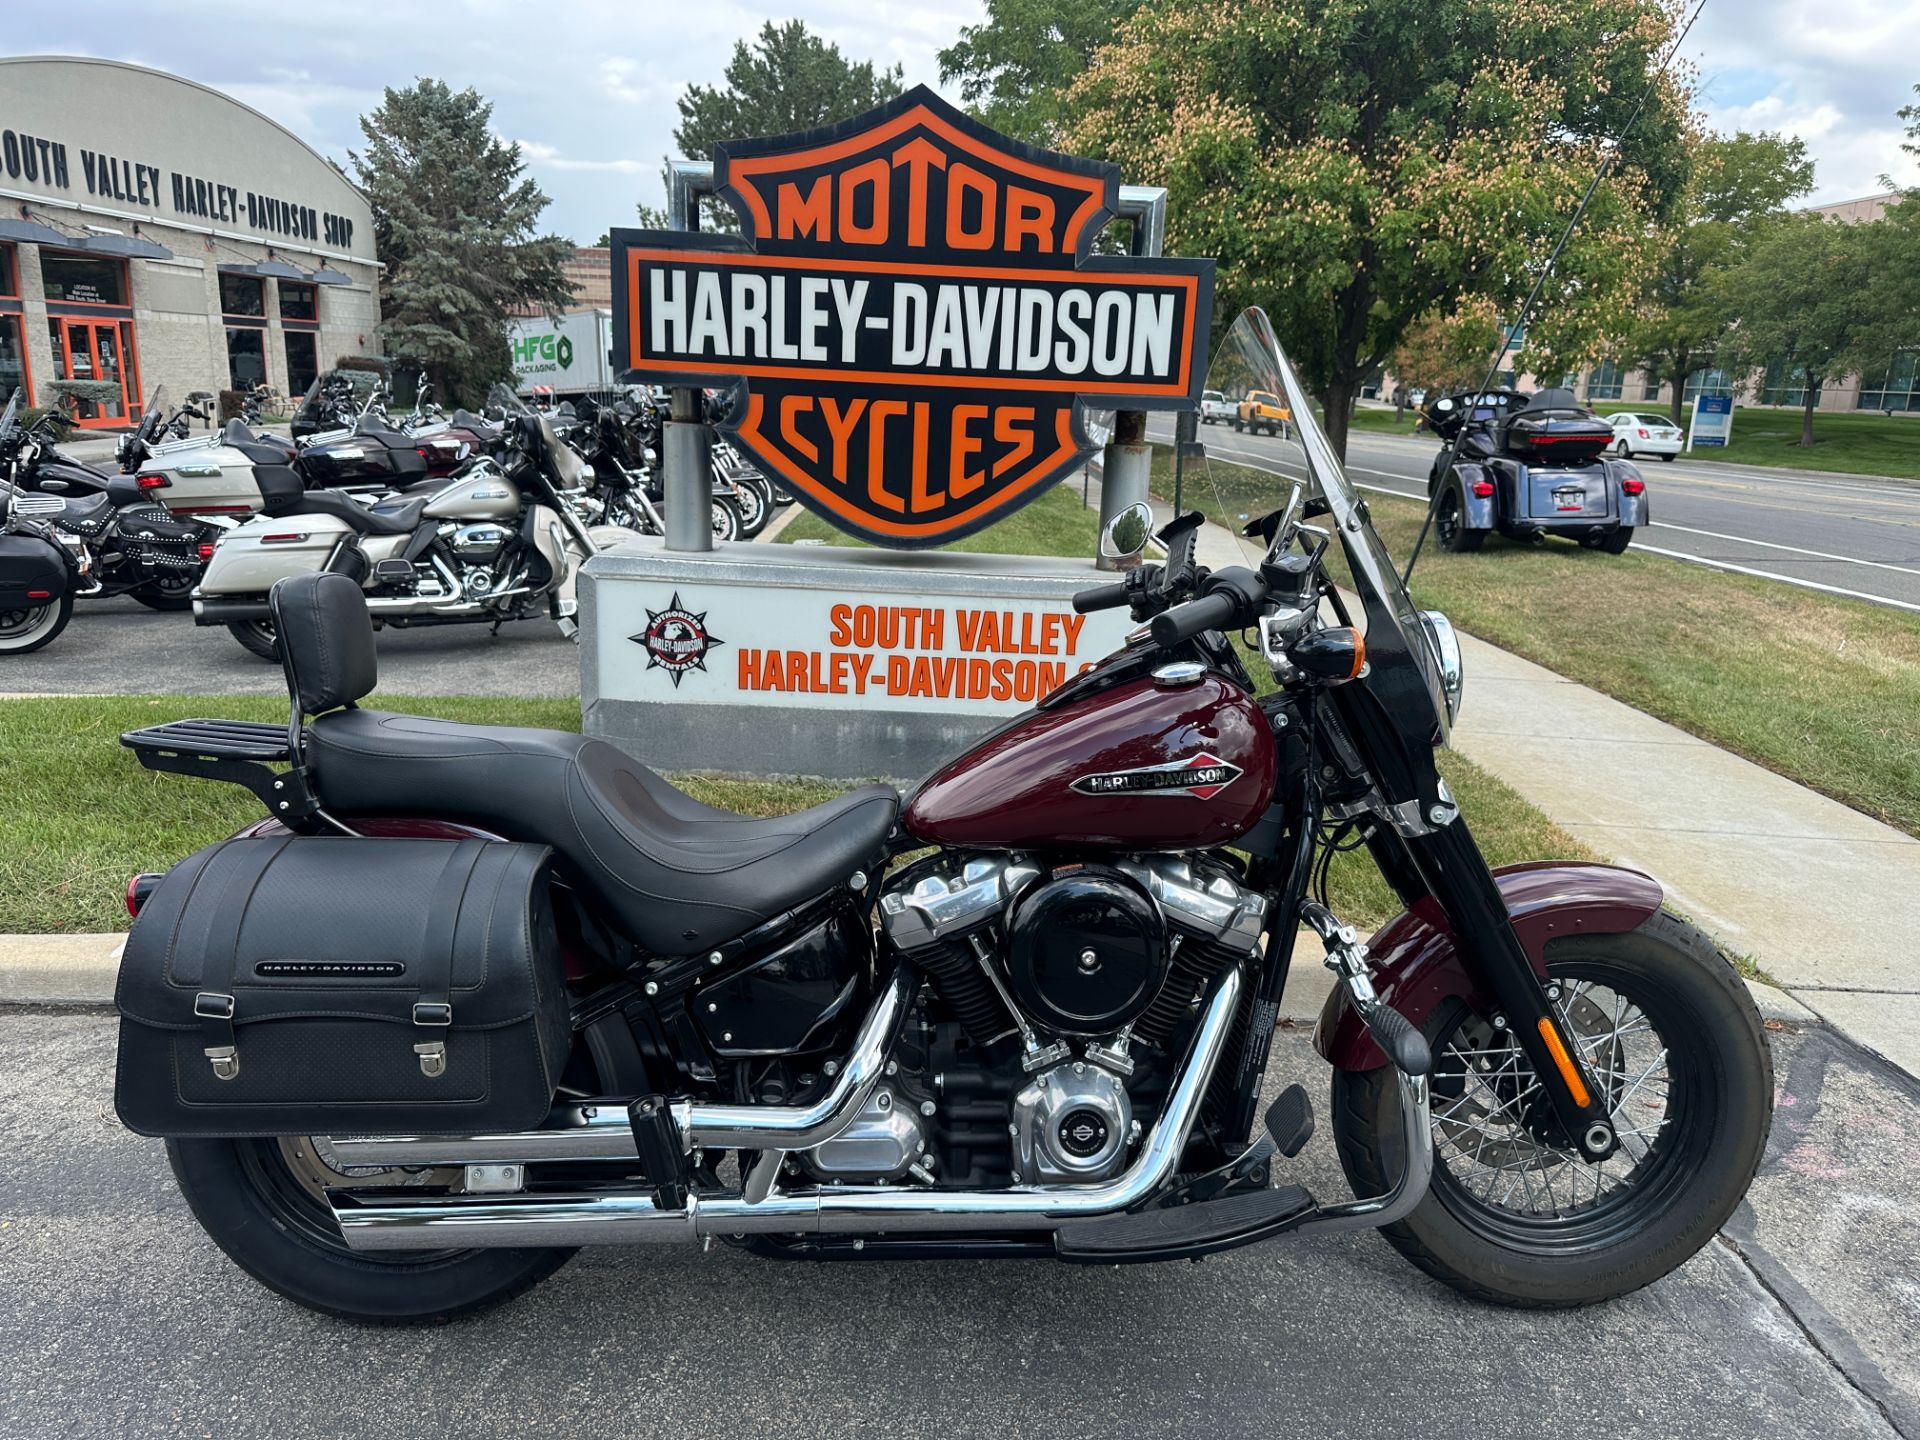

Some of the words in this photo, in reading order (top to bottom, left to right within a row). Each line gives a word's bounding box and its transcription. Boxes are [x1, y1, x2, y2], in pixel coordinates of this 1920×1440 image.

[0, 129, 70, 190] OUTH
[80, 149, 160, 208] VALLEY
[171, 172, 318, 241] HARLEY-DAVIDSON
[323, 211, 353, 249] SHOP
[778, 137, 1056, 254] MOTOR
[650, 268, 1176, 378] HARLEY-DAVIDSON
[513, 334, 556, 363] HFG
[516, 364, 557, 374] PACKAGING
[779, 394, 1036, 514] CYCLES
[651, 610, 702, 630] AUTHORIZED
[830, 602, 945, 651] SOUTH
[956, 609, 1087, 656] VALLEY
[649, 635, 704, 653] HARLEY-DAVIDSON
[653, 654, 700, 671] RENTALS
[738, 648, 1066, 702] HARLEY-DAVIDSON
[1091, 768, 1226, 793] HARLEY-DAVIDSON
